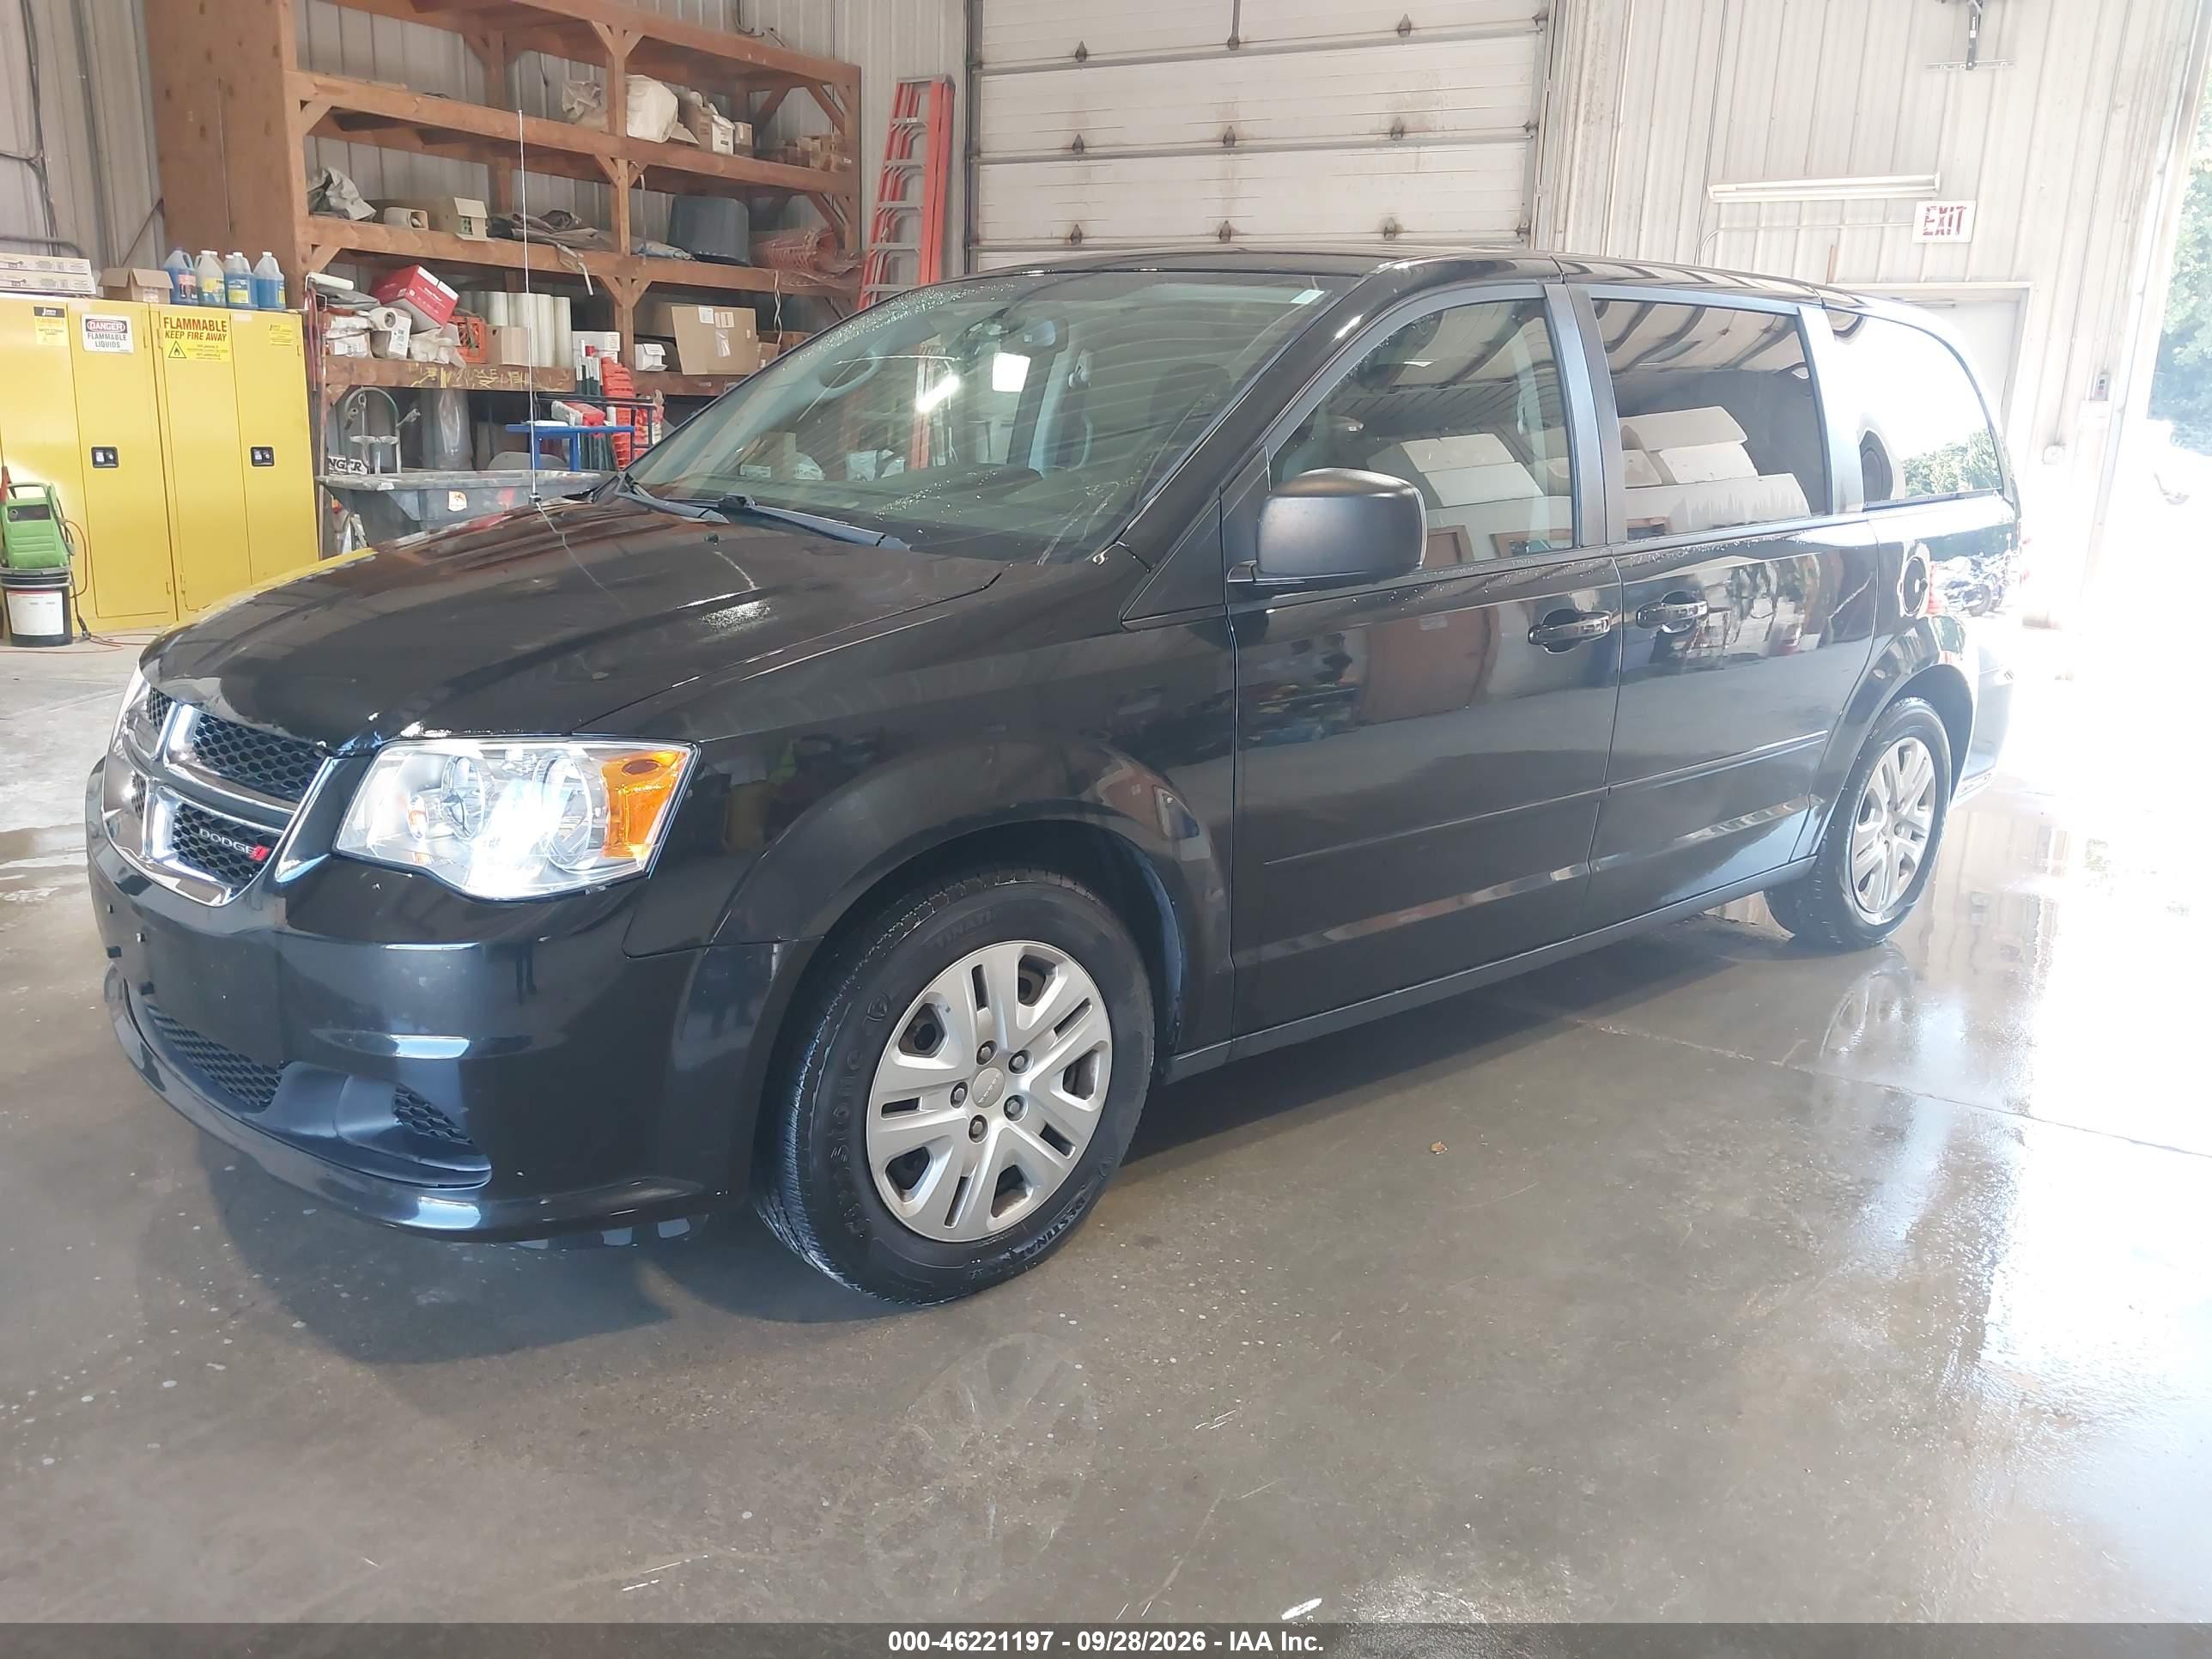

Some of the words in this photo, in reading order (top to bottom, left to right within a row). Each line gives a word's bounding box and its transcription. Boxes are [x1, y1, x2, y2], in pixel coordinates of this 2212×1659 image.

[1923, 205, 1966, 236] EXIT
[89, 321, 123, 331] DANGER
[163, 317, 228, 332] FLAMMABLE
[88, 332, 127, 341] FLAMMABLE
[165, 331, 185, 340] KEEP
[187, 331, 204, 341] FIRE
[205, 332, 227, 342] AWAY
[95, 340, 121, 349] LIQUIDS
[199, 828, 255, 854] DODGE
